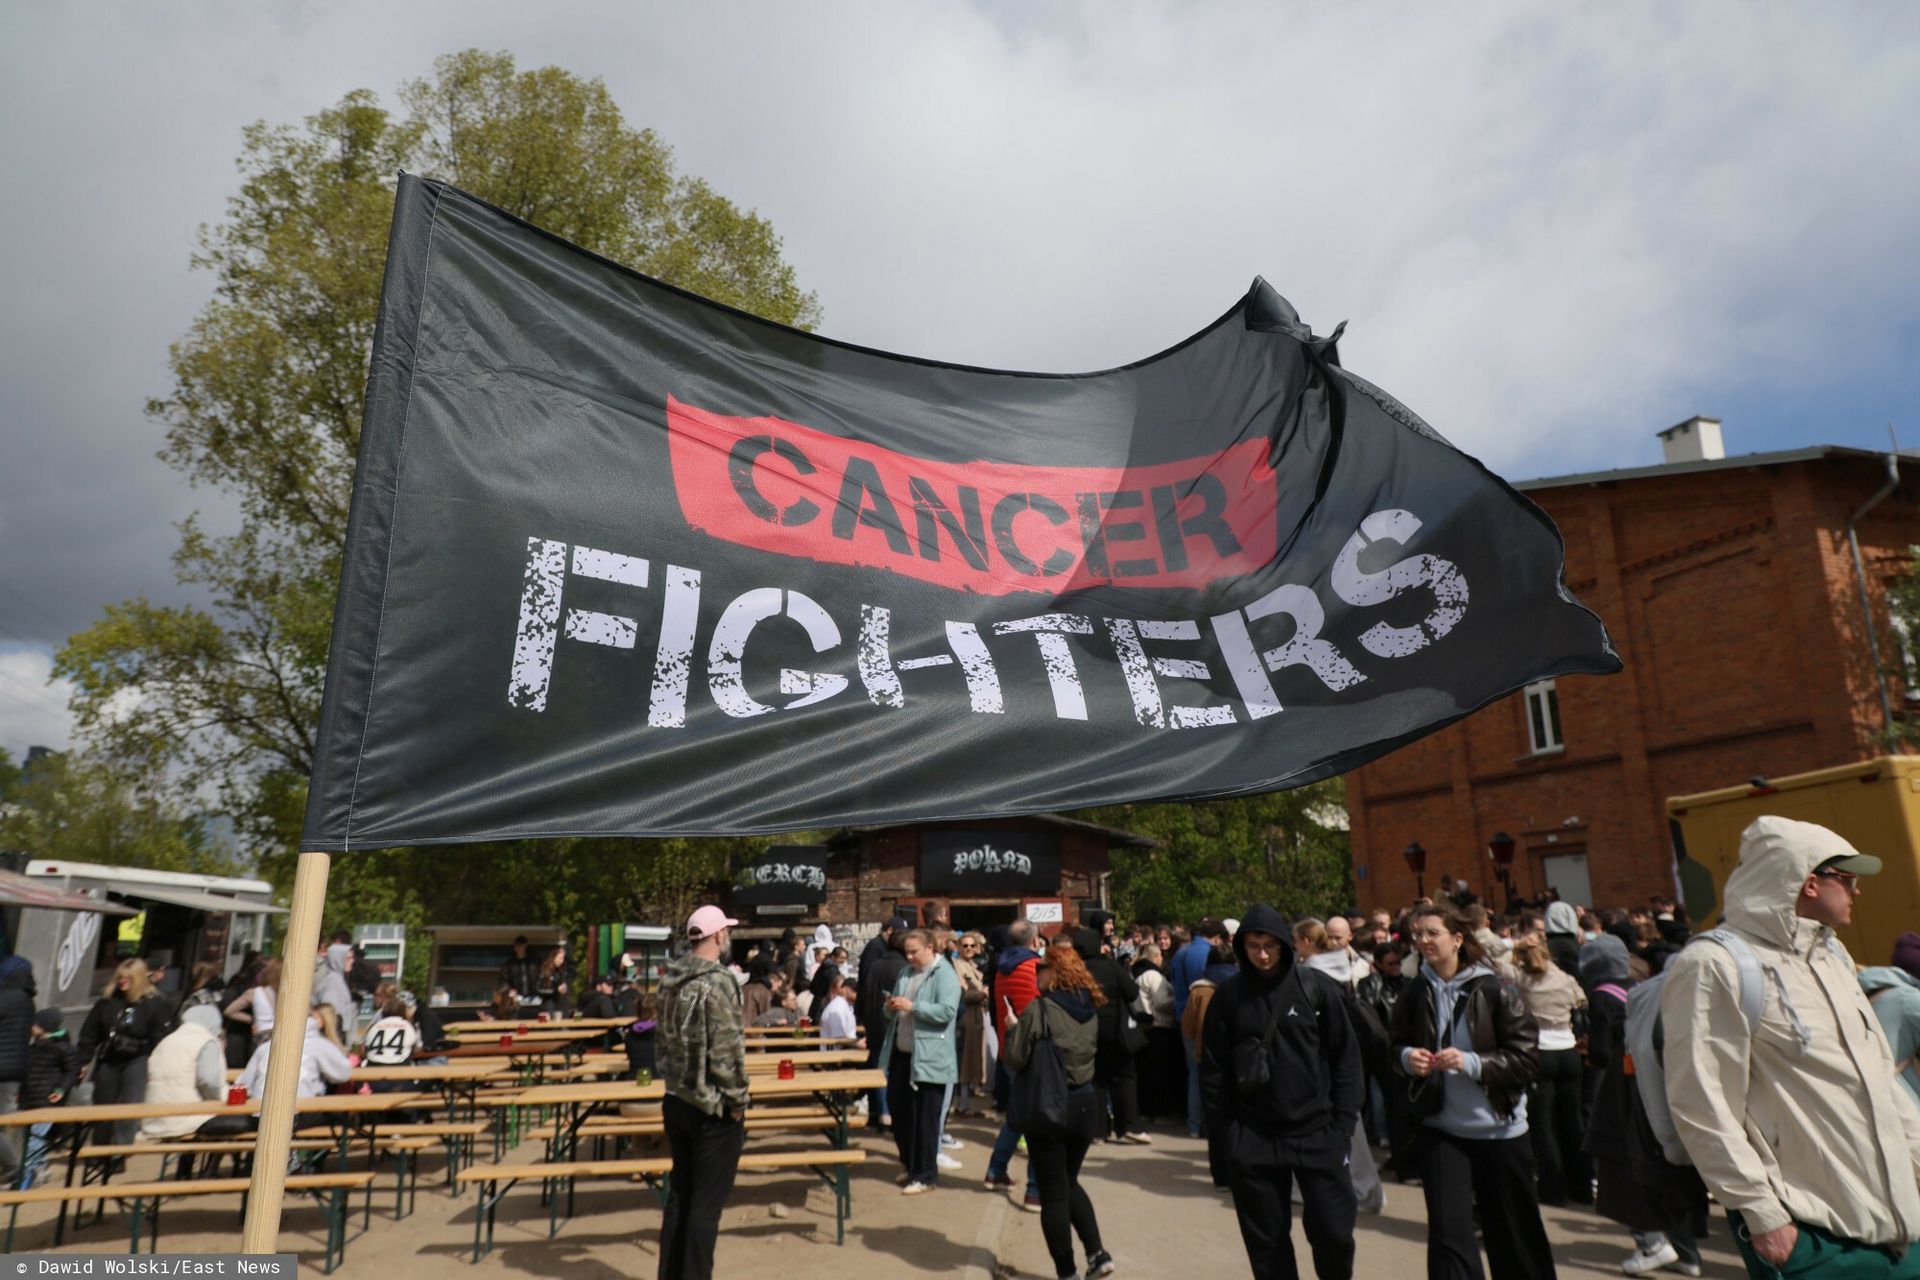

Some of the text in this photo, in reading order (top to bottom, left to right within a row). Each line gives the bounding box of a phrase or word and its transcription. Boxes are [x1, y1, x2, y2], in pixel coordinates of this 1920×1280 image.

[728, 434, 1244, 578] CANCER
[508, 509, 1470, 728] FIGHTERS
[368, 1029, 405, 1055] 44
